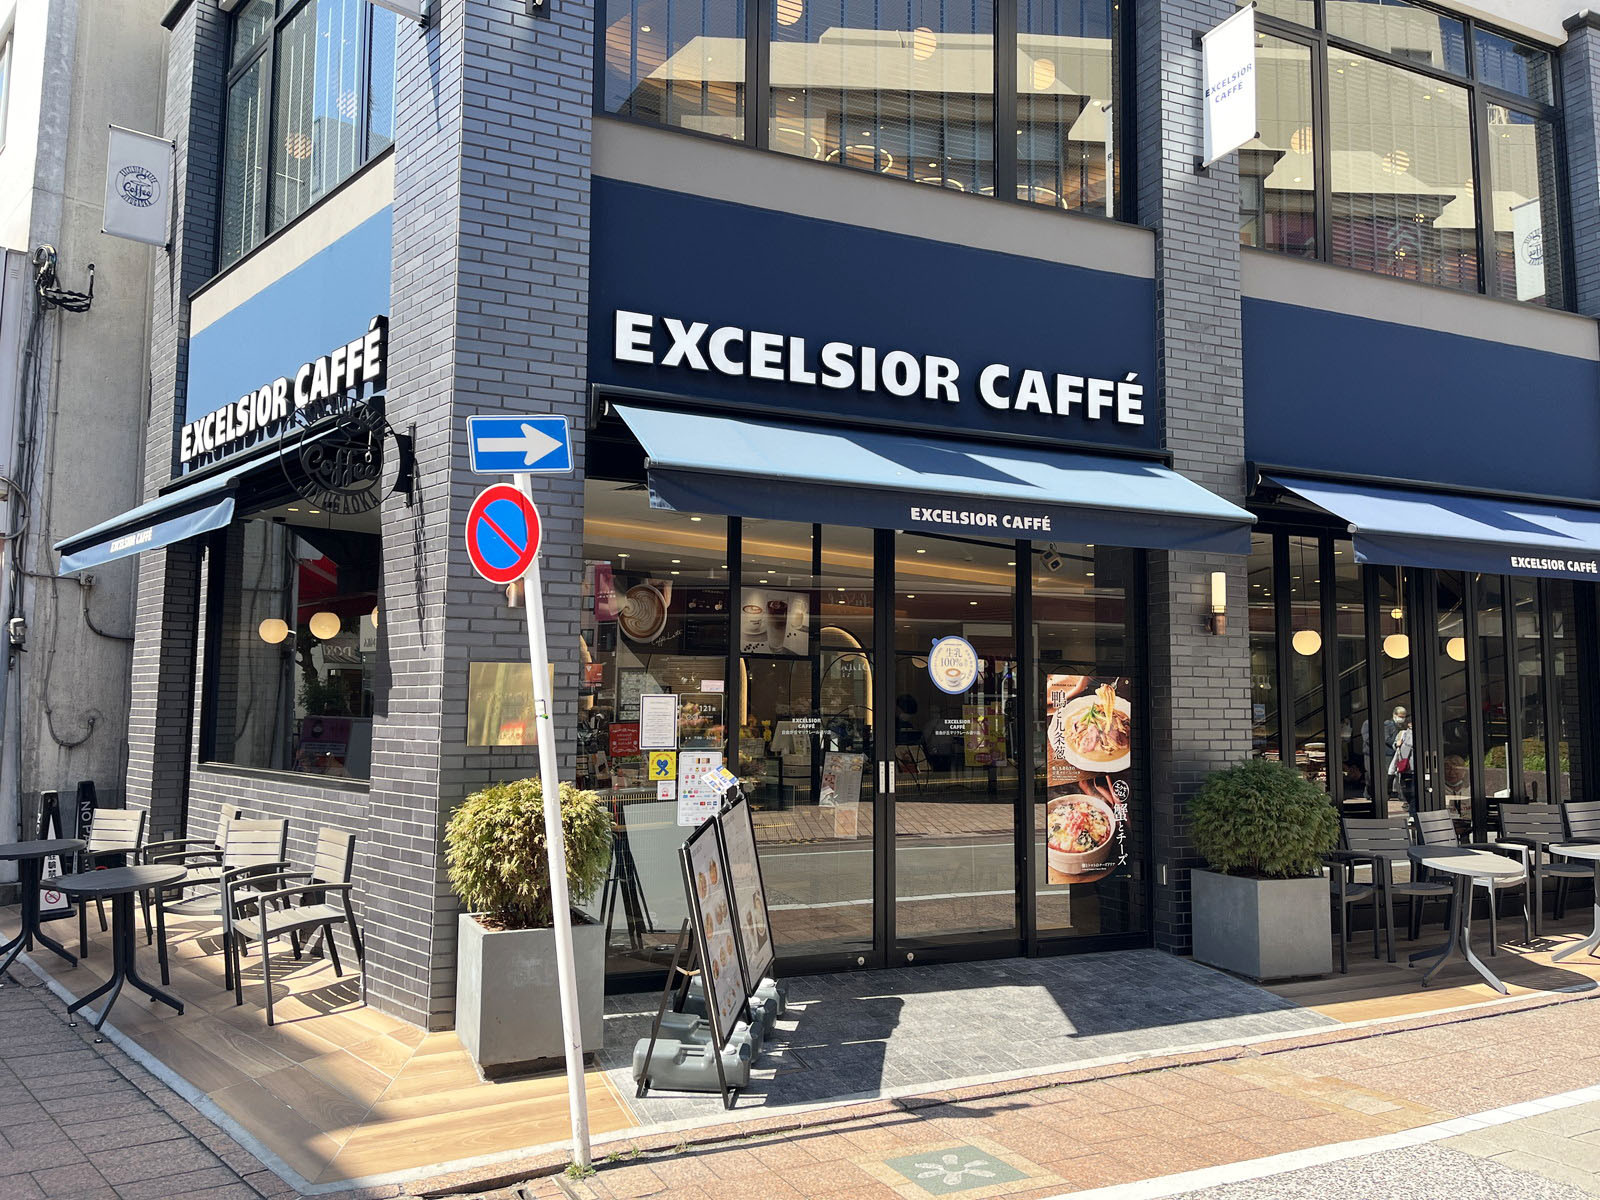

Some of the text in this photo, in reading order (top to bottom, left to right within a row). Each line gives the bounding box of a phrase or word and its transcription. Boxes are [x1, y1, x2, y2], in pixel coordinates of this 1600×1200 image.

[1205, 63, 1252, 98] EXCELSIOR
[123, 181, 152, 198] Coffee
[615, 309, 1145, 425] EXCELSIOR CAFFÉ
[180, 316, 382, 464] EXCELSIOR CAFFÉ
[302, 443, 377, 488] Coffee
[910, 507, 1052, 533] EXCELSIOR CAFFÉ
[1511, 556, 1598, 574] EXCELSIOR CAFFÉ
[940, 658, 963, 667] 100%
[946, 648, 962, 658] 生乳
[1051, 690, 1067, 760] 鴨と九条葱
[81, 801, 92, 821] NO
[1114, 803, 1128, 865] 蟹とチーズ
